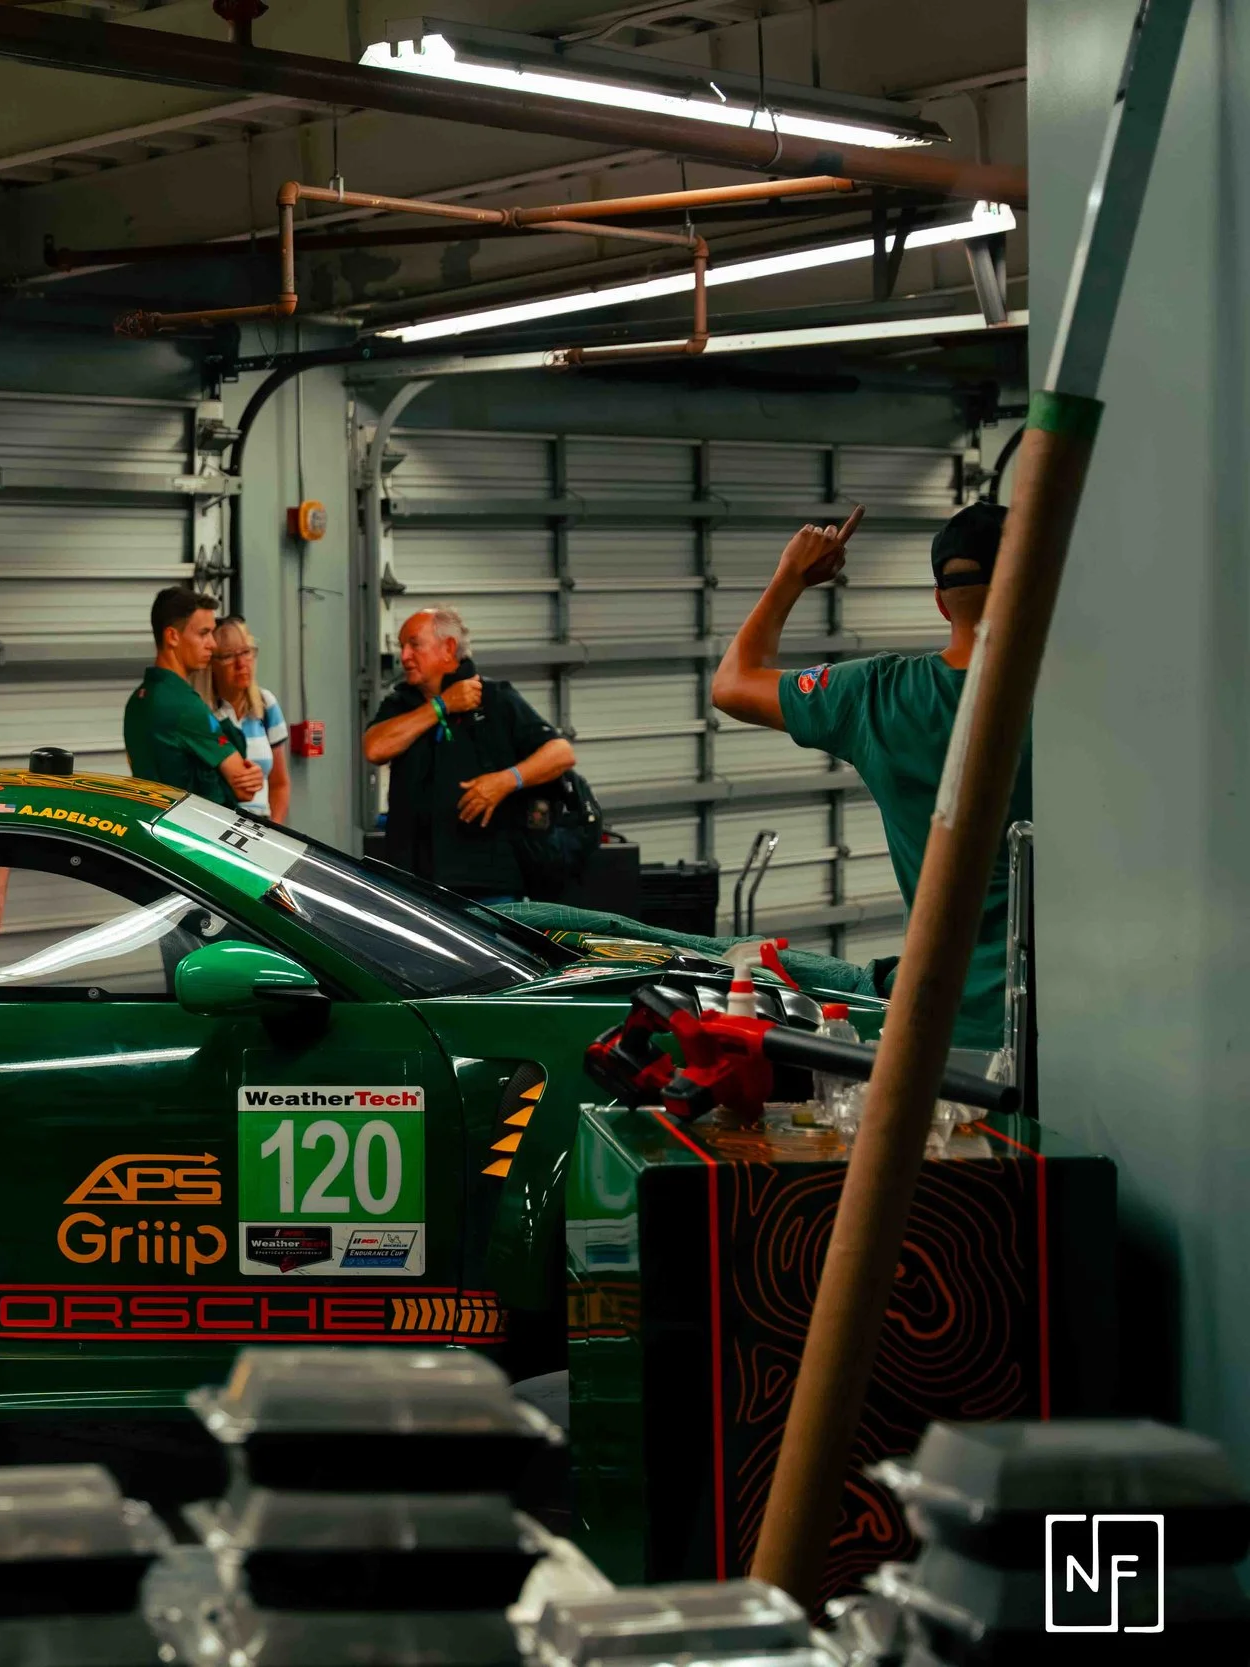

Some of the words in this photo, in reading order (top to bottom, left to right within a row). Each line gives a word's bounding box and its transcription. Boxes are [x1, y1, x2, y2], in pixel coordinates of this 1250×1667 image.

[17, 805, 129, 838] A.ADELSON
[245, 1091, 419, 1108] WeatherTech
[63, 1153, 222, 1204] APS
[260, 1119, 403, 1216] 120
[57, 1212, 227, 1276] Griiip
